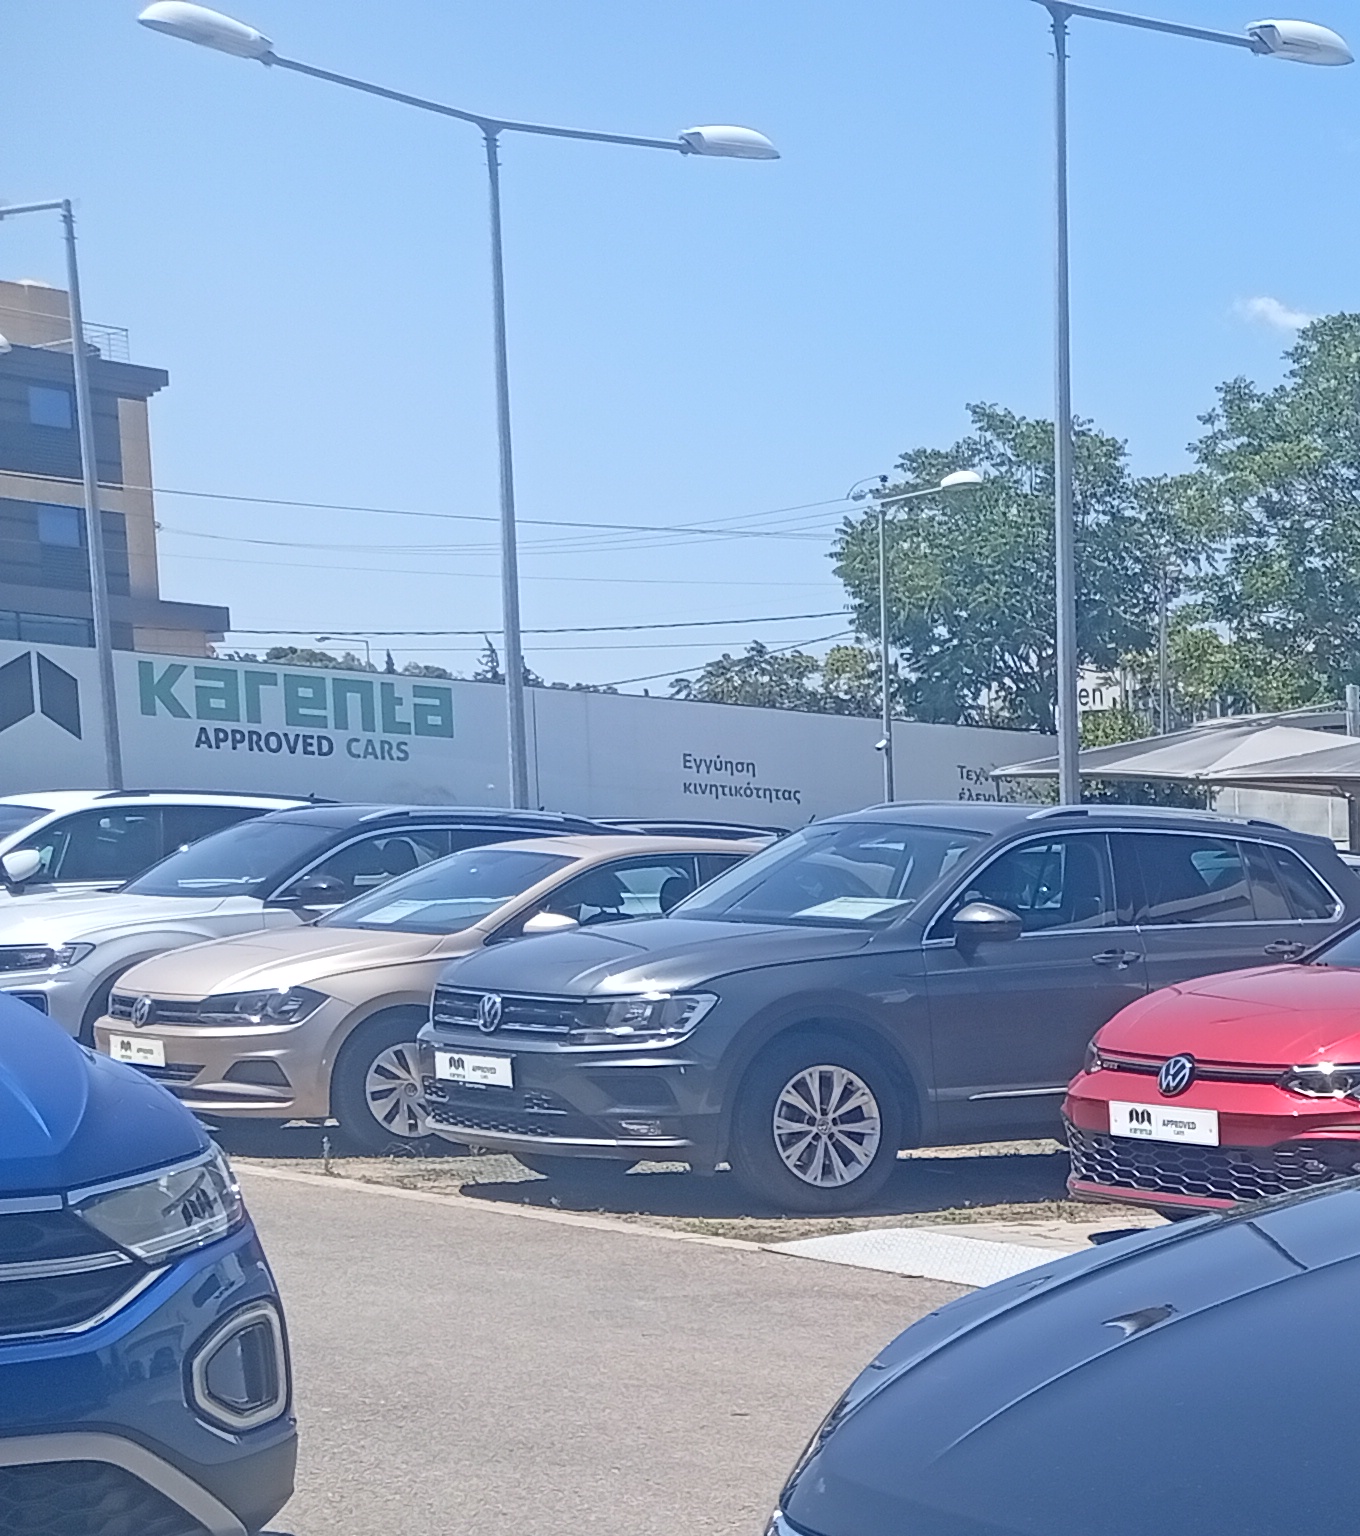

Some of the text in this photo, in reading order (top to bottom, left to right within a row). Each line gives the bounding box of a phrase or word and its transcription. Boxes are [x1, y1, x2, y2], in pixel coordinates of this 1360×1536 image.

[195, 726, 410, 762] APPROVED CARS
[682, 753, 756, 778] Εγγύηση
[683, 782, 801, 805] κινητικότητας
